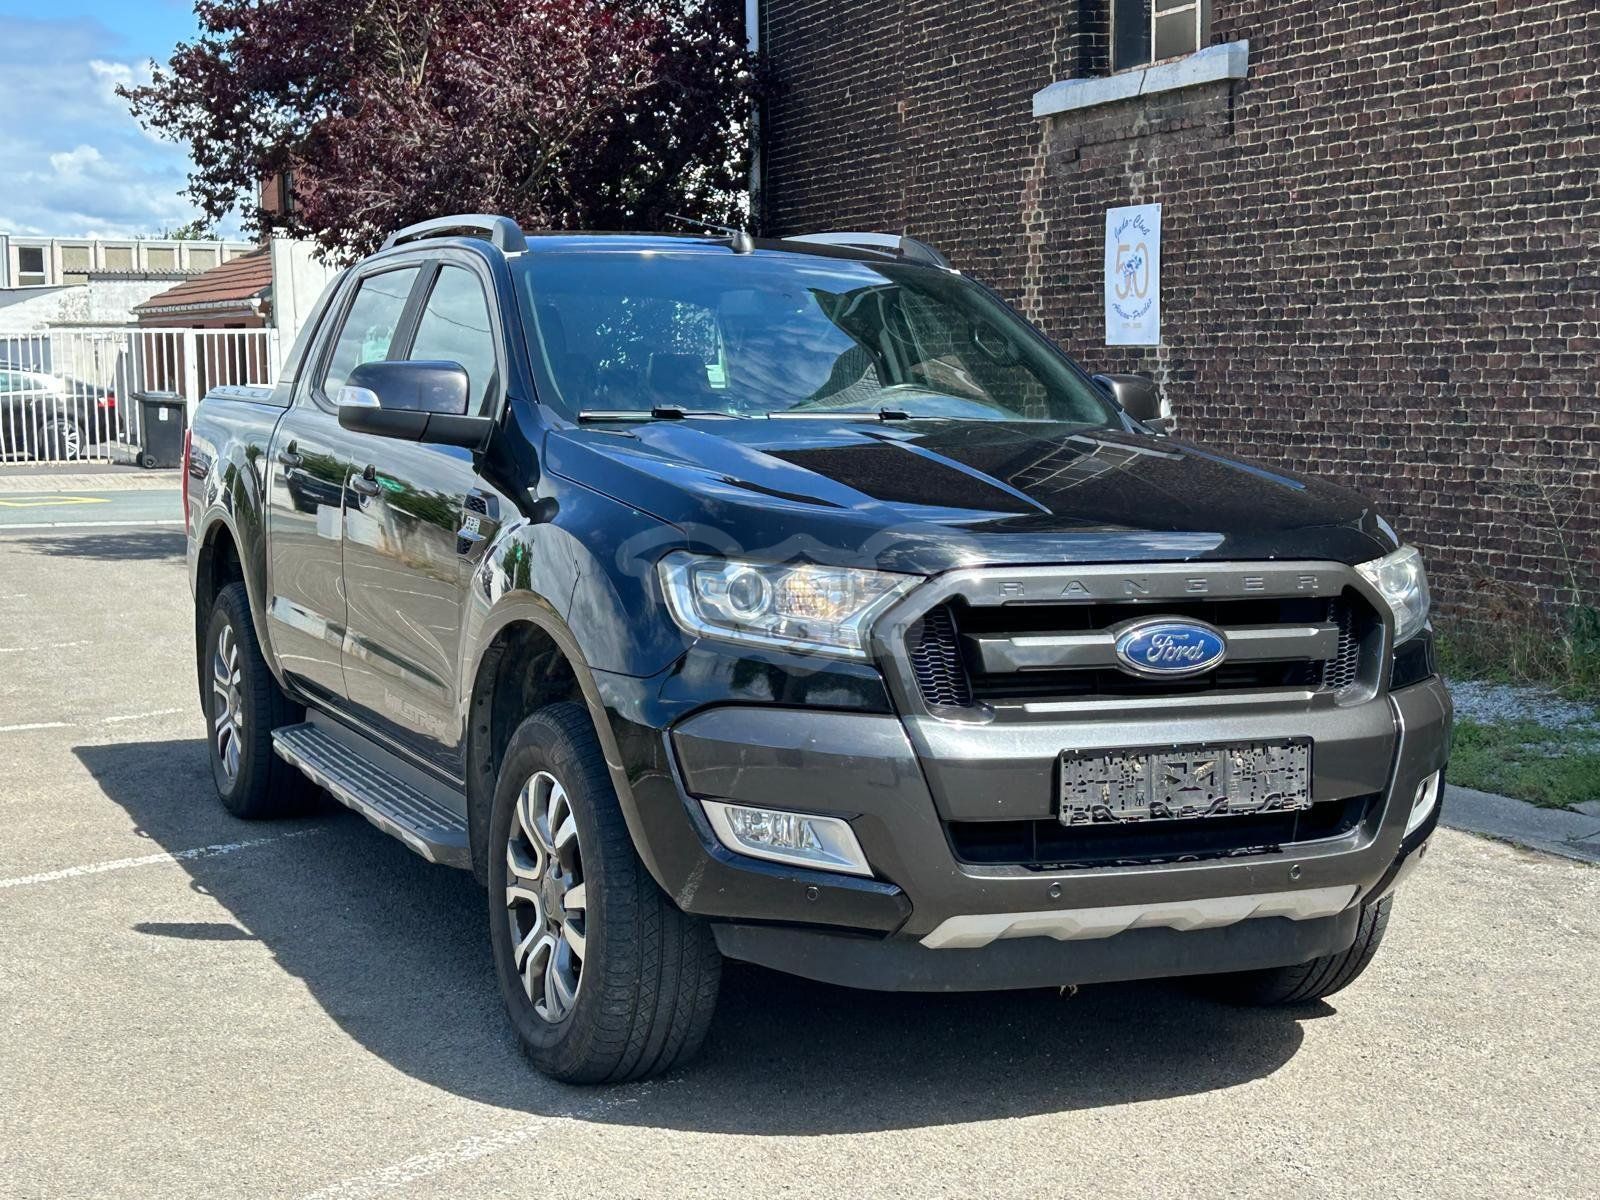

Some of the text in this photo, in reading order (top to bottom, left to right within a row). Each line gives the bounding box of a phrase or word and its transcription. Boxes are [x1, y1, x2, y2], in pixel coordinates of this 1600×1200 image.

[1115, 241, 1150, 300] 50
[999, 574, 1319, 597] RANGER
[1146, 633, 1205, 662] Ford
